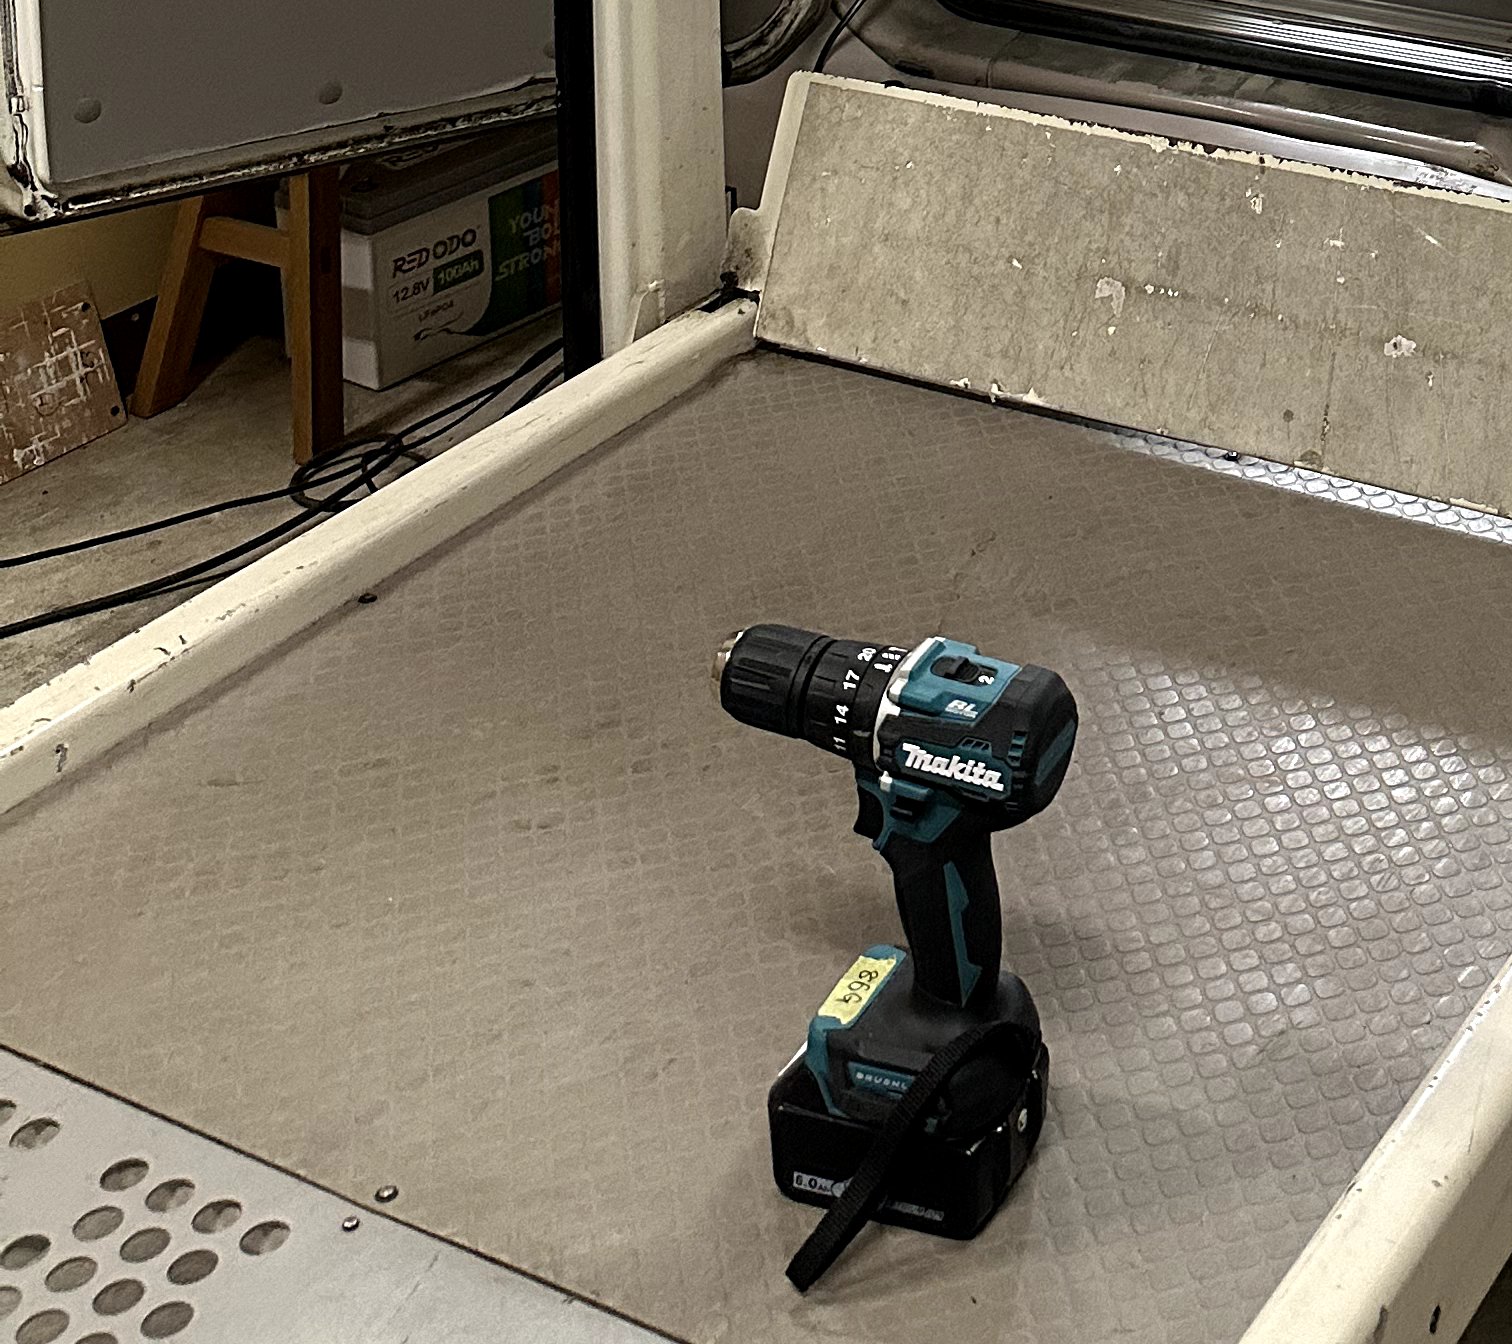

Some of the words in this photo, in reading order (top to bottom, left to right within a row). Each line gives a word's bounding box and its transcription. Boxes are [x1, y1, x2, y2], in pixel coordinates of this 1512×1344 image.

[393, 277, 431, 303] 12.8V
[437, 259, 480, 284] 100Ah
[843, 669, 860, 690] 17
[978, 675, 995, 685] 2
[835, 704, 849, 725] 14
[833, 736, 847, 751] 11
